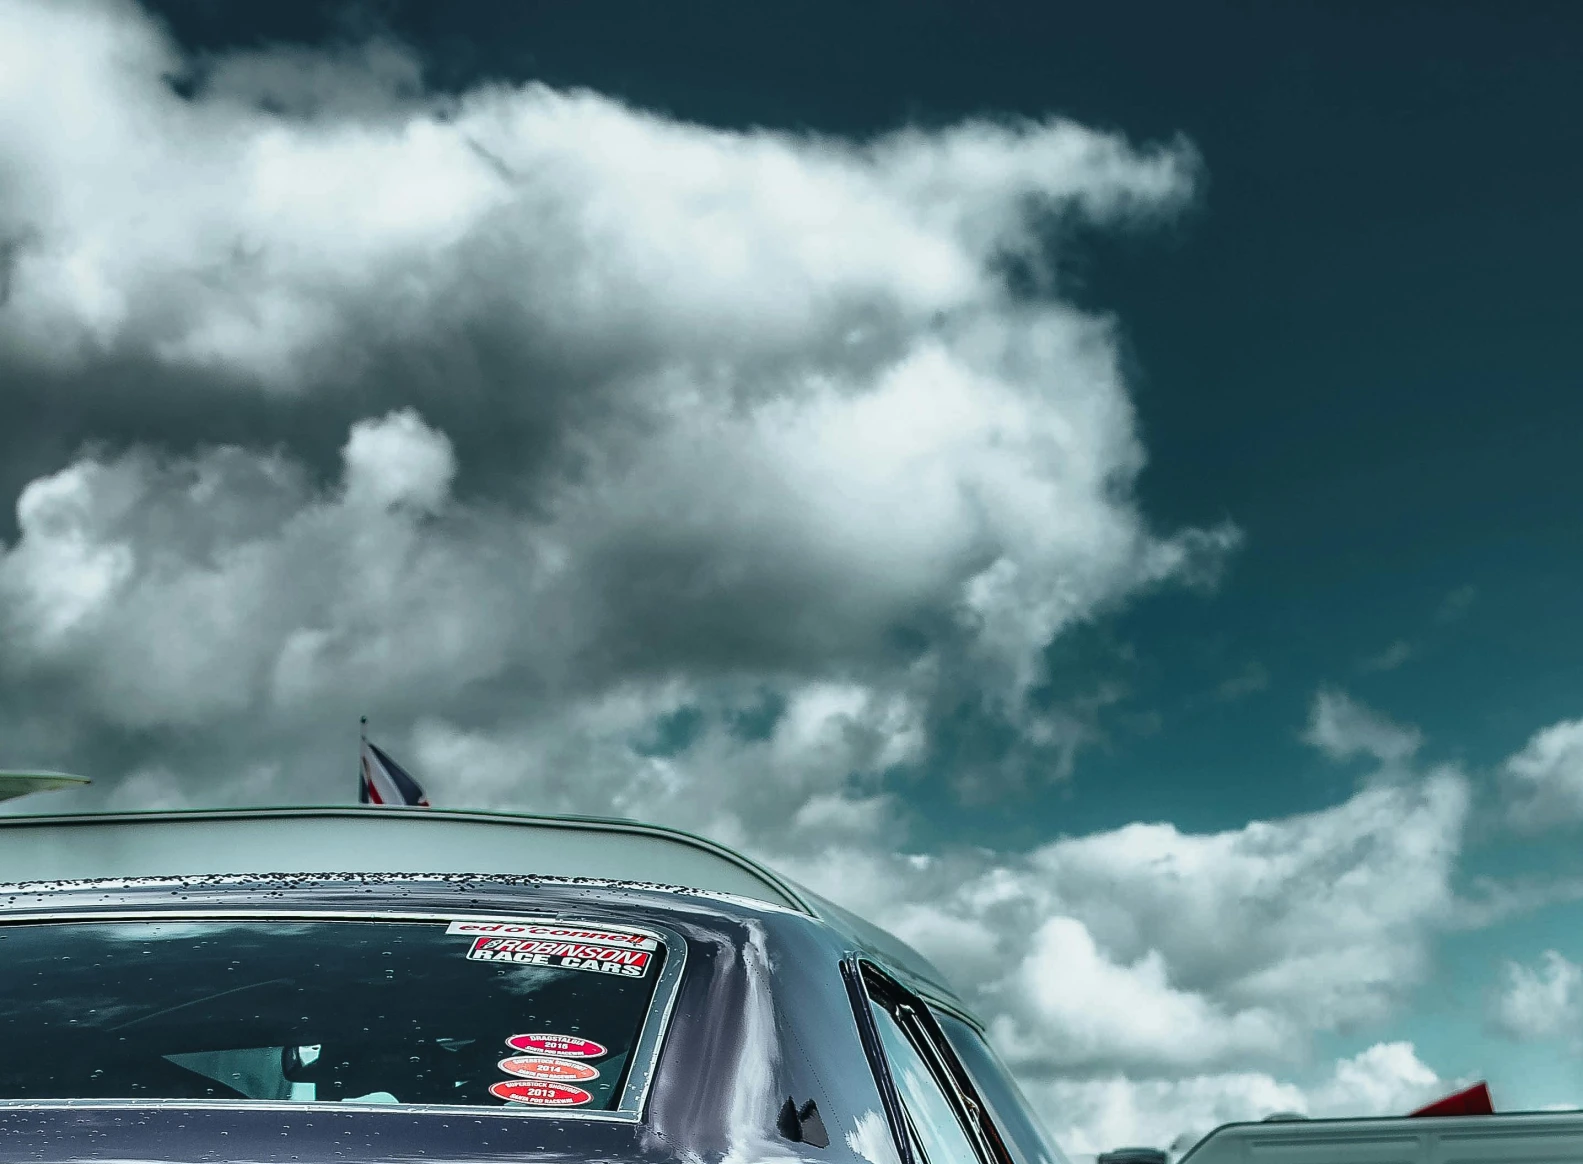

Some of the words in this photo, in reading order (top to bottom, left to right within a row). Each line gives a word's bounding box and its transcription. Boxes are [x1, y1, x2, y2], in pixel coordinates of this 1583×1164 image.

[493, 939, 642, 964] ROBINSON
[472, 950, 551, 965] RACE
[560, 956, 642, 976] CARS
[536, 1064, 561, 1073] 2014
[527, 1088, 555, 1097] 2013
